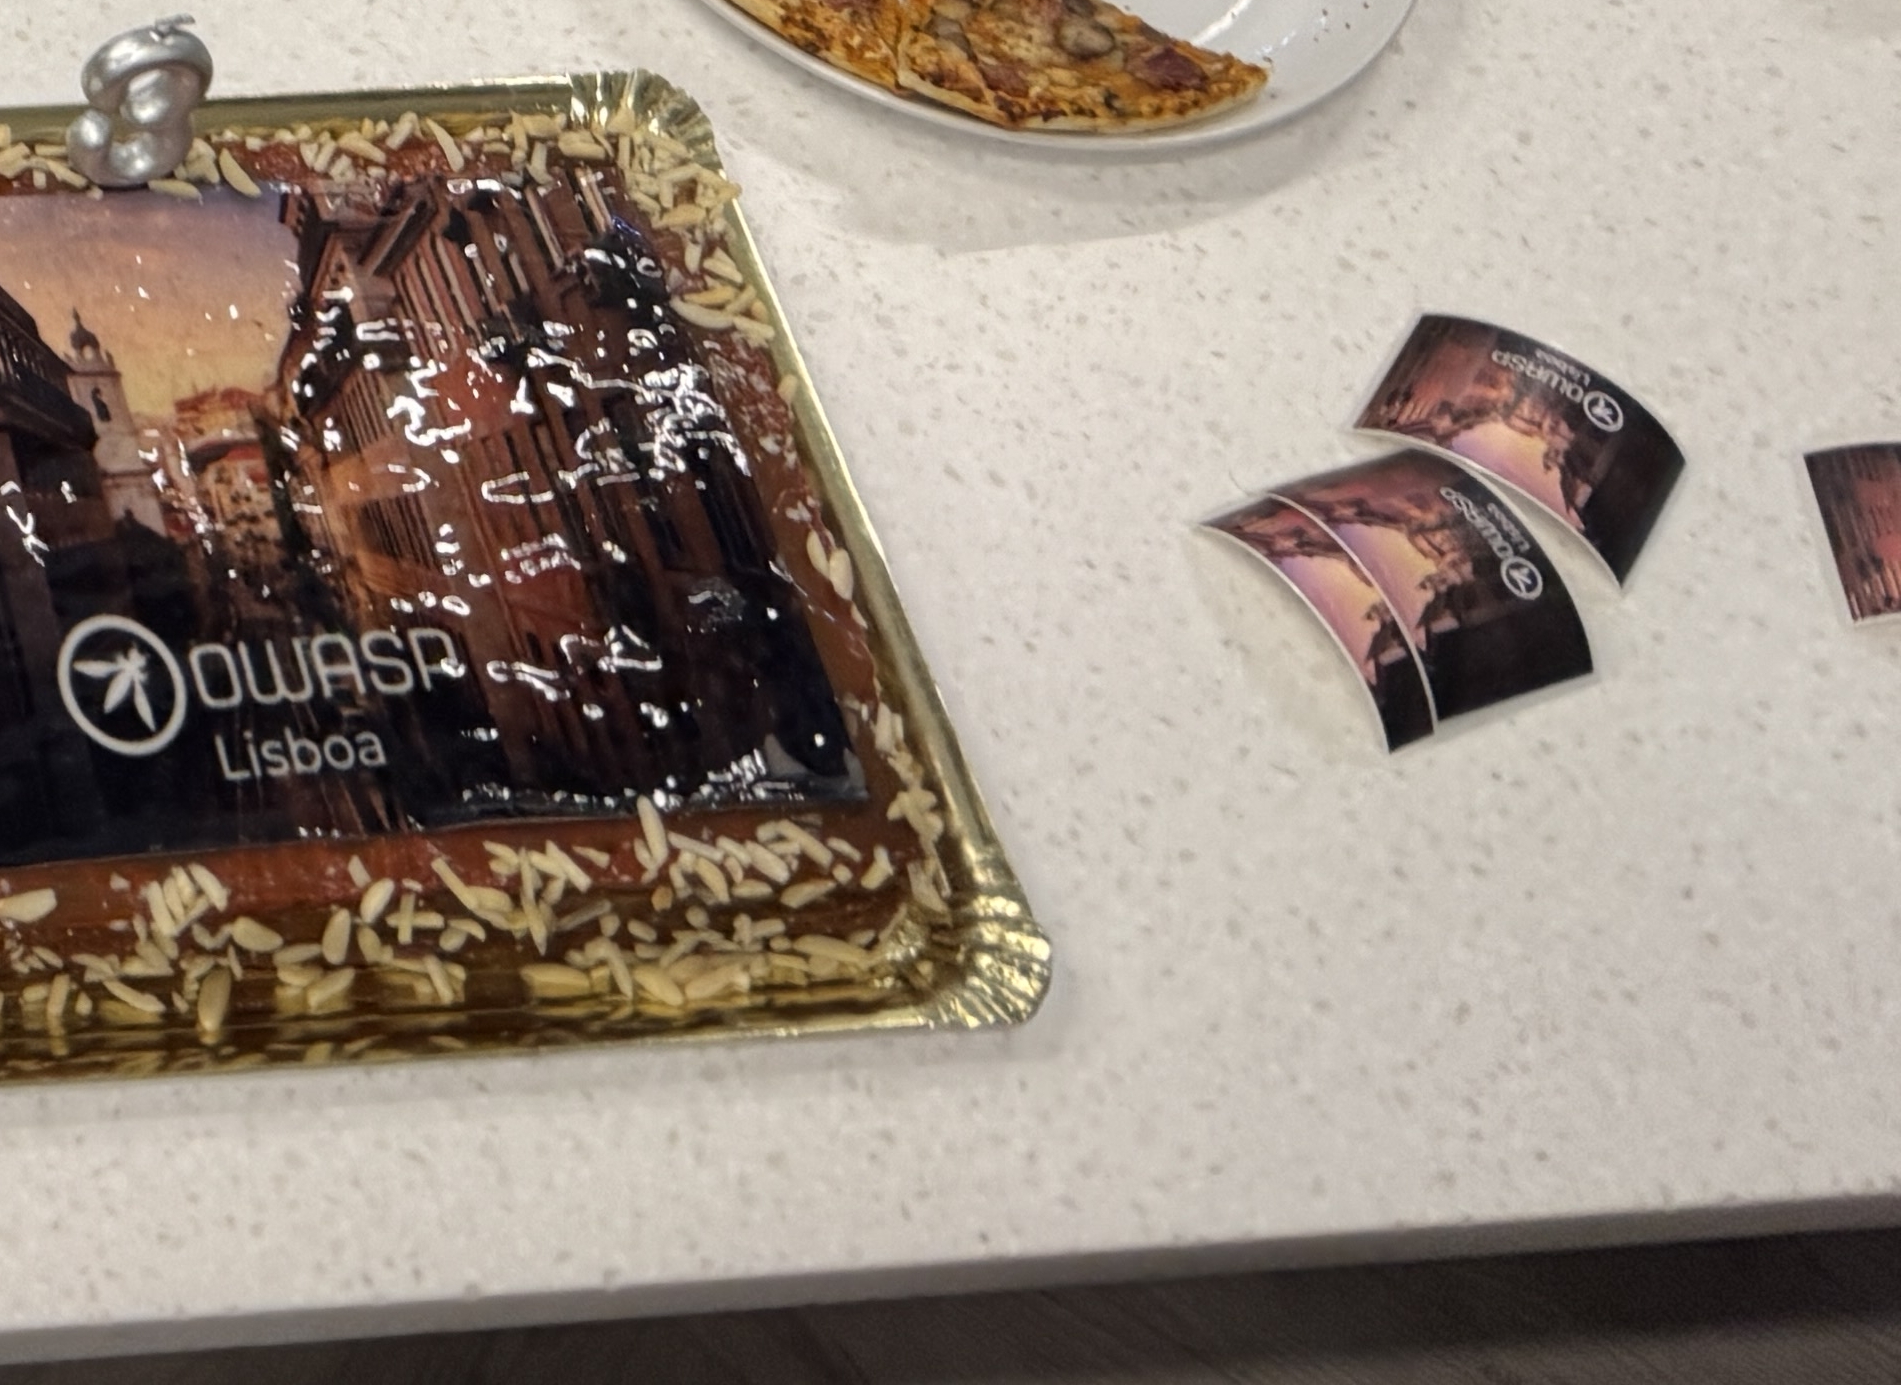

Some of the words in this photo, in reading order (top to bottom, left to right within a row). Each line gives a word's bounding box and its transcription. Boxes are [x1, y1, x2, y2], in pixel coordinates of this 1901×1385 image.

[1492, 349, 1584, 403] OWASP
[189, 626, 466, 708] OWASP
[214, 725, 388, 781] Lisboa
